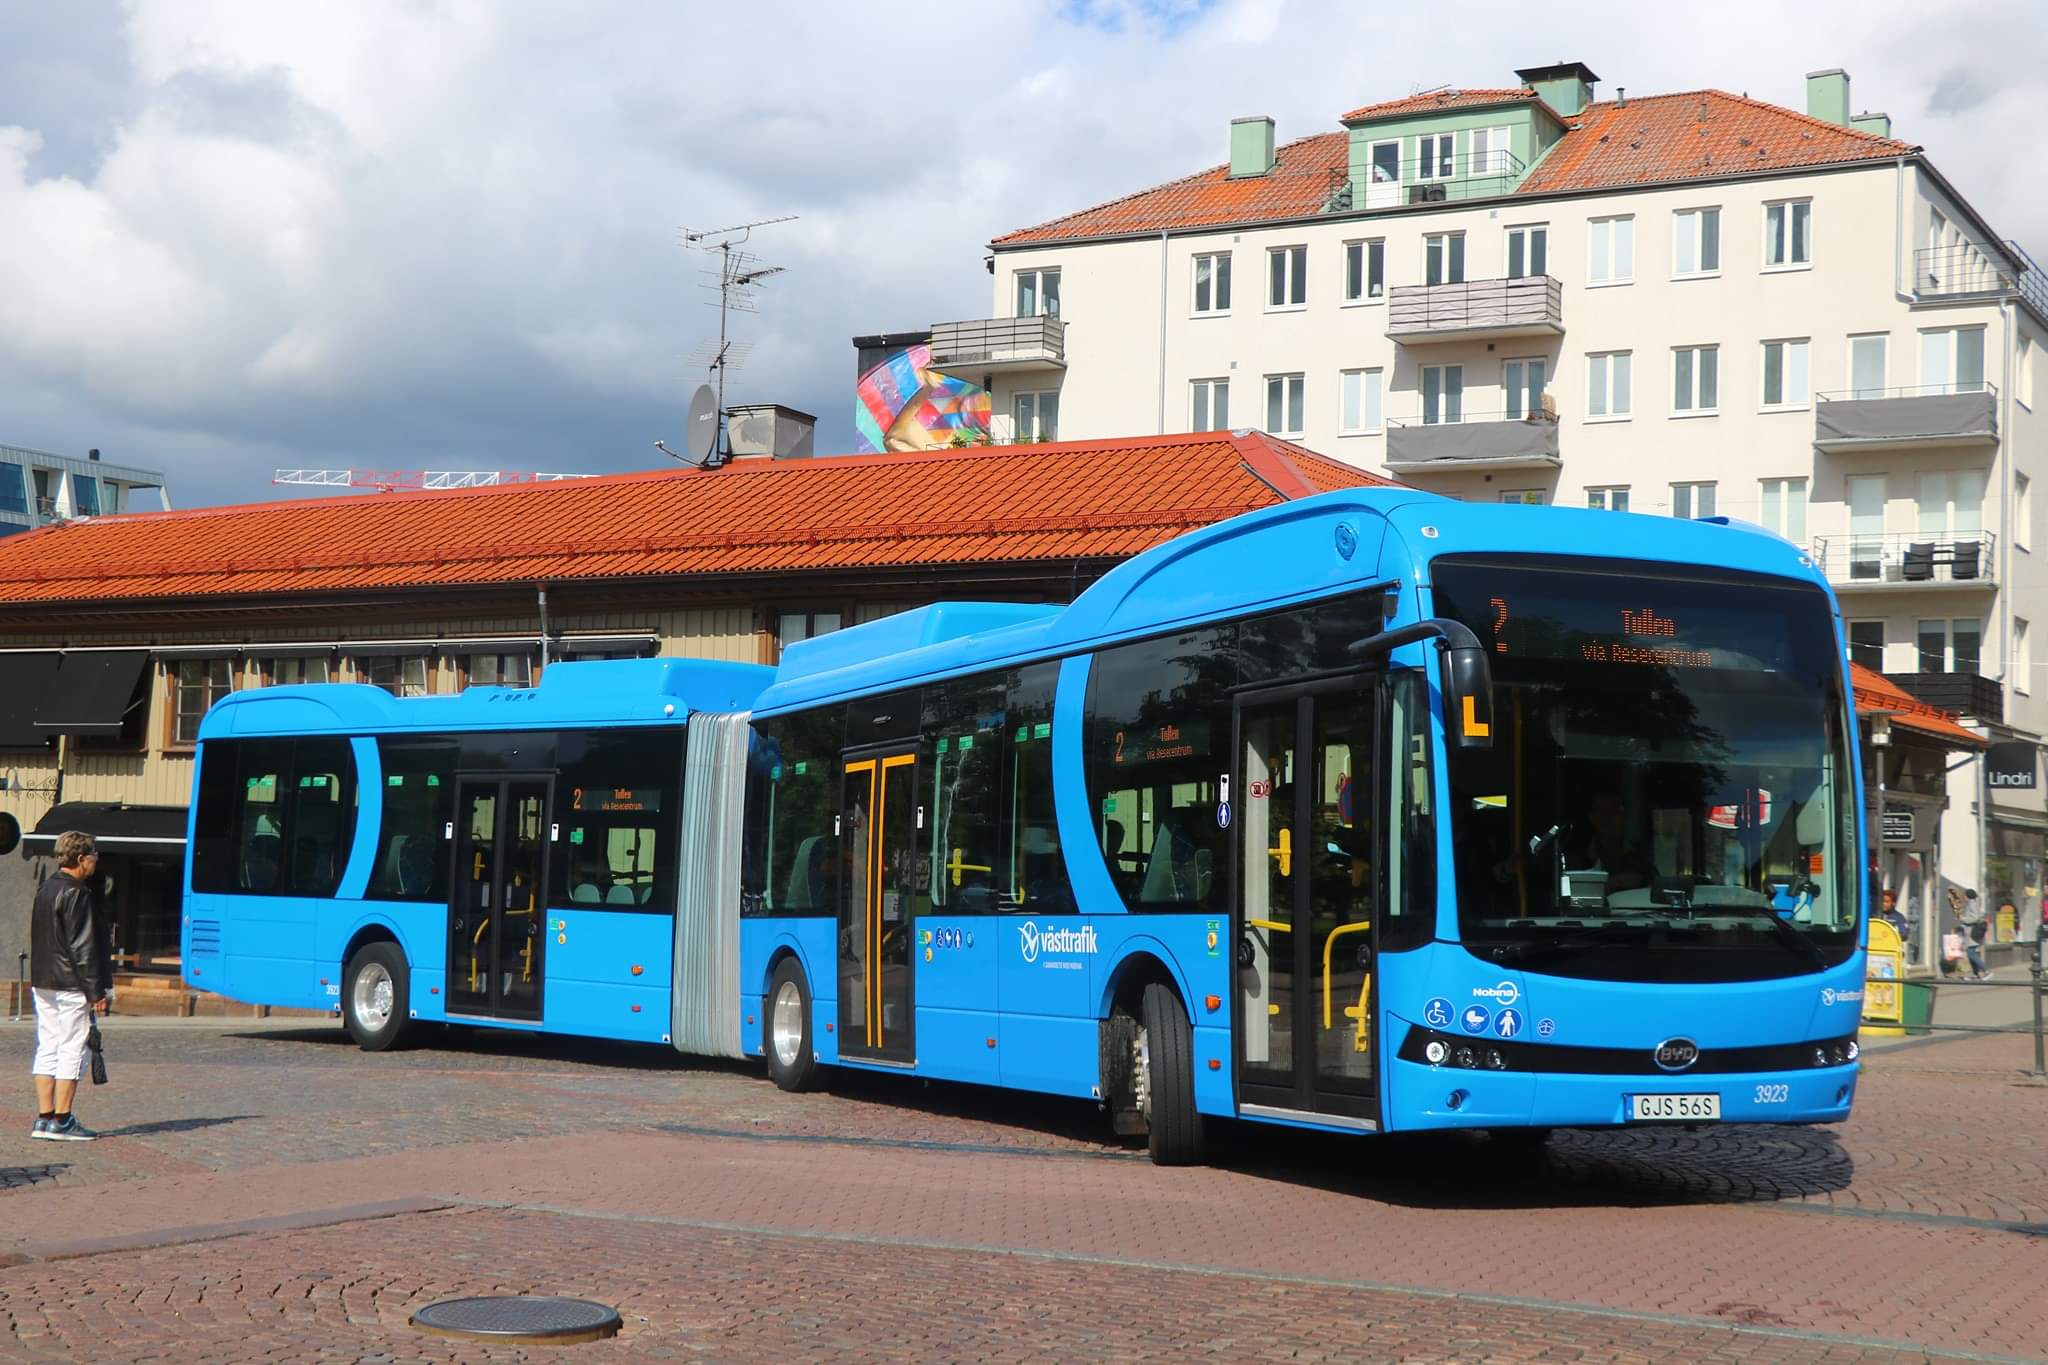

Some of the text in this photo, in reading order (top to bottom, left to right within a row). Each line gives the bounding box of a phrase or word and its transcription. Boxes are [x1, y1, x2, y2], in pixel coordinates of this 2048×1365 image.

[1620, 608, 1675, 636] Tullen
[1582, 640, 1607, 661] via
[1115, 732, 1124, 762] 2
[573, 788, 581, 808] 2
[1041, 926, 1098, 953] västtrafik
[1660, 1047, 1693, 1061] BYD
[1753, 1084, 1789, 1103] 3923
[1641, 1097, 1712, 1116] GJS 56S
